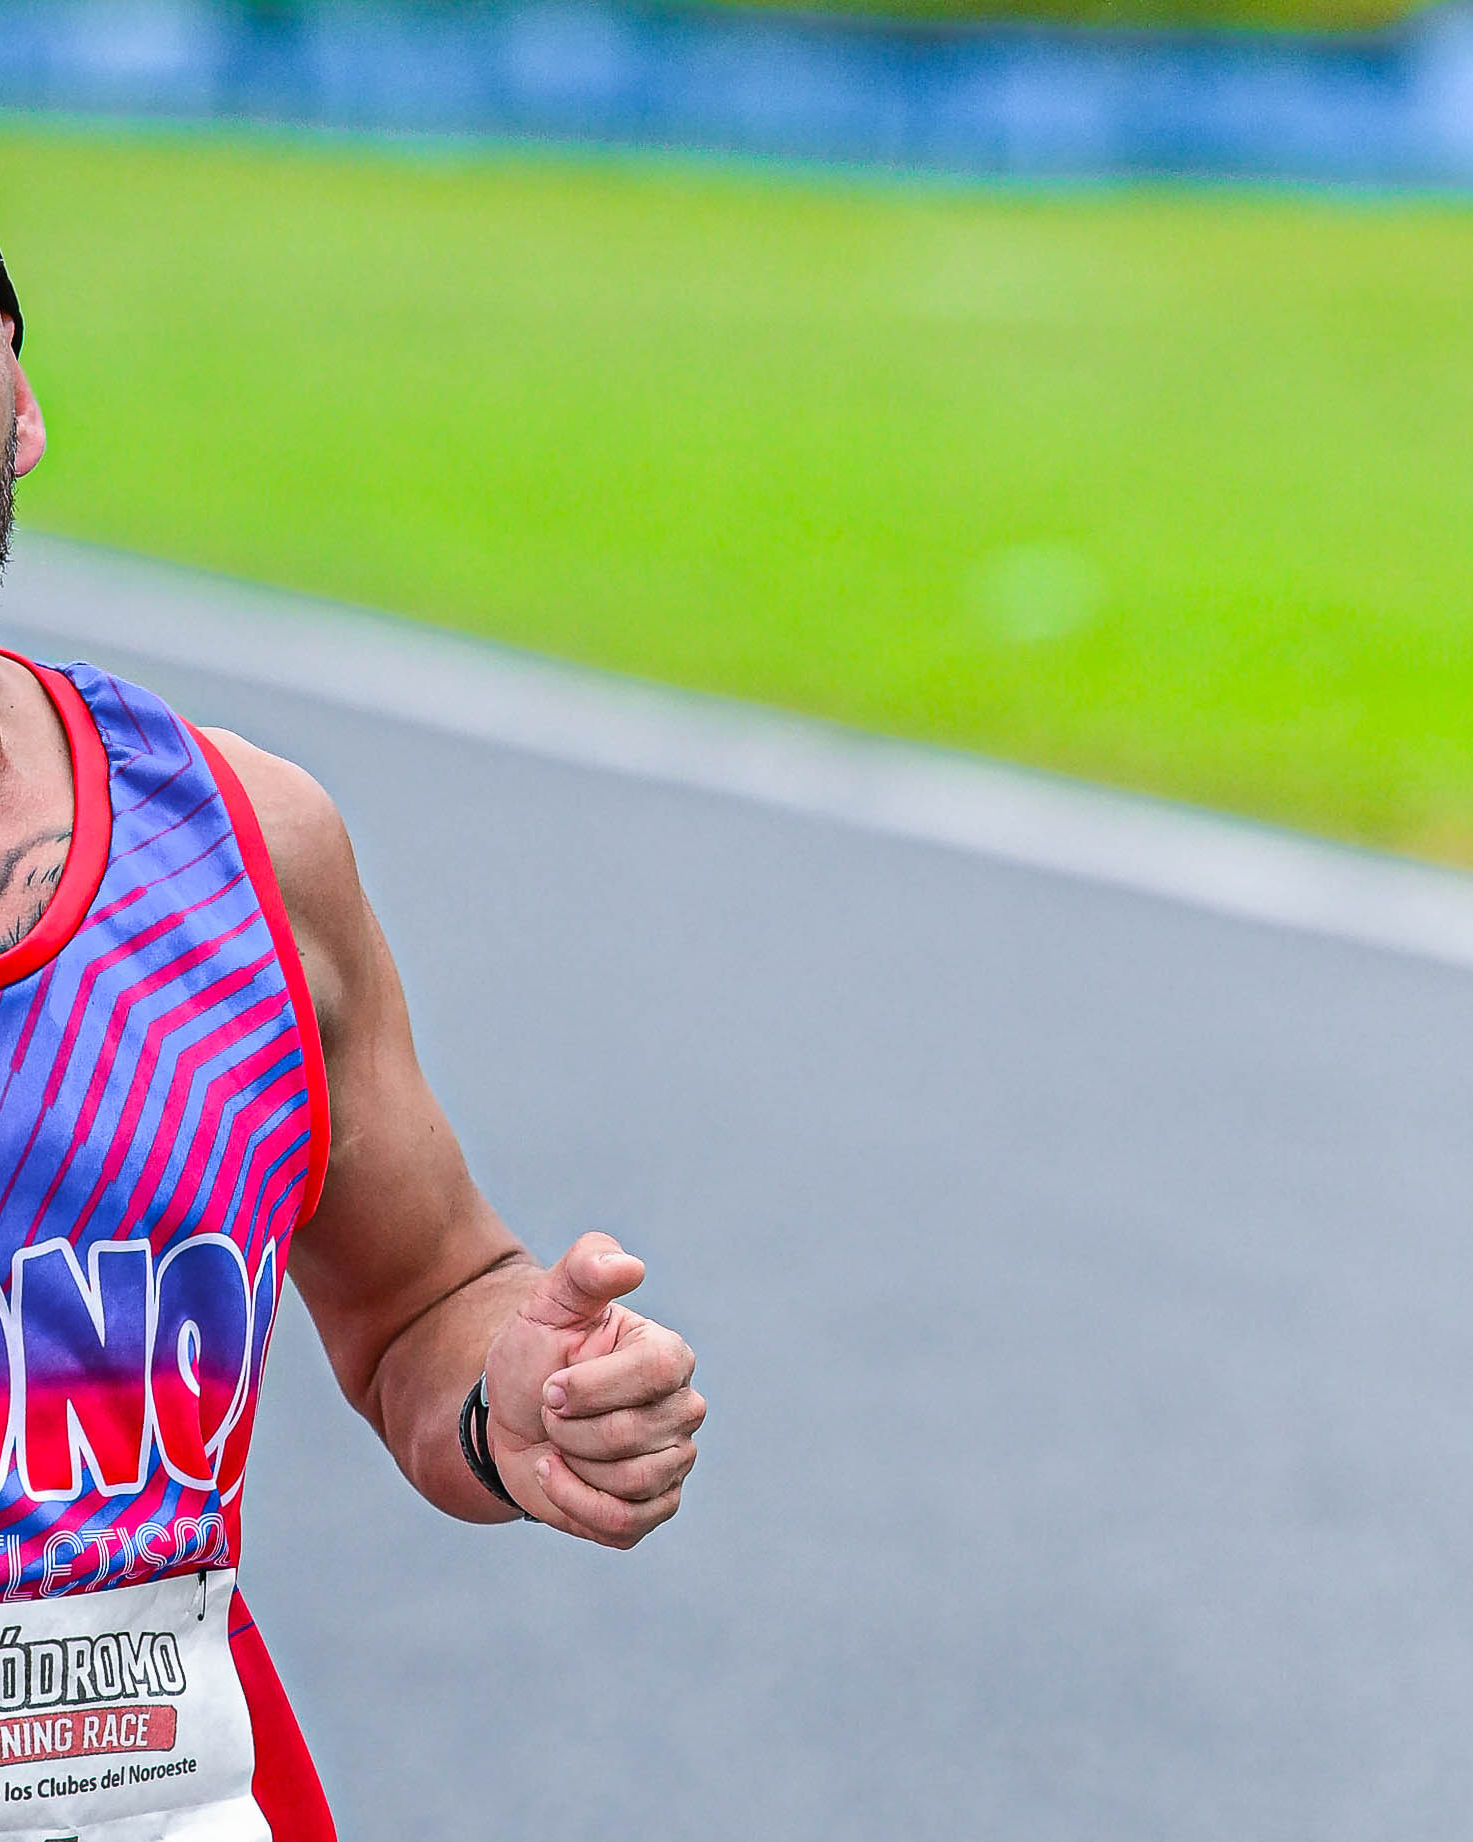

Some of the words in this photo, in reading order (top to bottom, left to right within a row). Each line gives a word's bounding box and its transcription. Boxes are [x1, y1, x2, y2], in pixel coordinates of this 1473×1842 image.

[82, 1711, 150, 1750] RACE
[4, 1781, 33, 1803] los
[36, 1774, 97, 1799] Clubes
[100, 1765, 126, 1790] del
[128, 1756, 198, 1786] Noroeste
